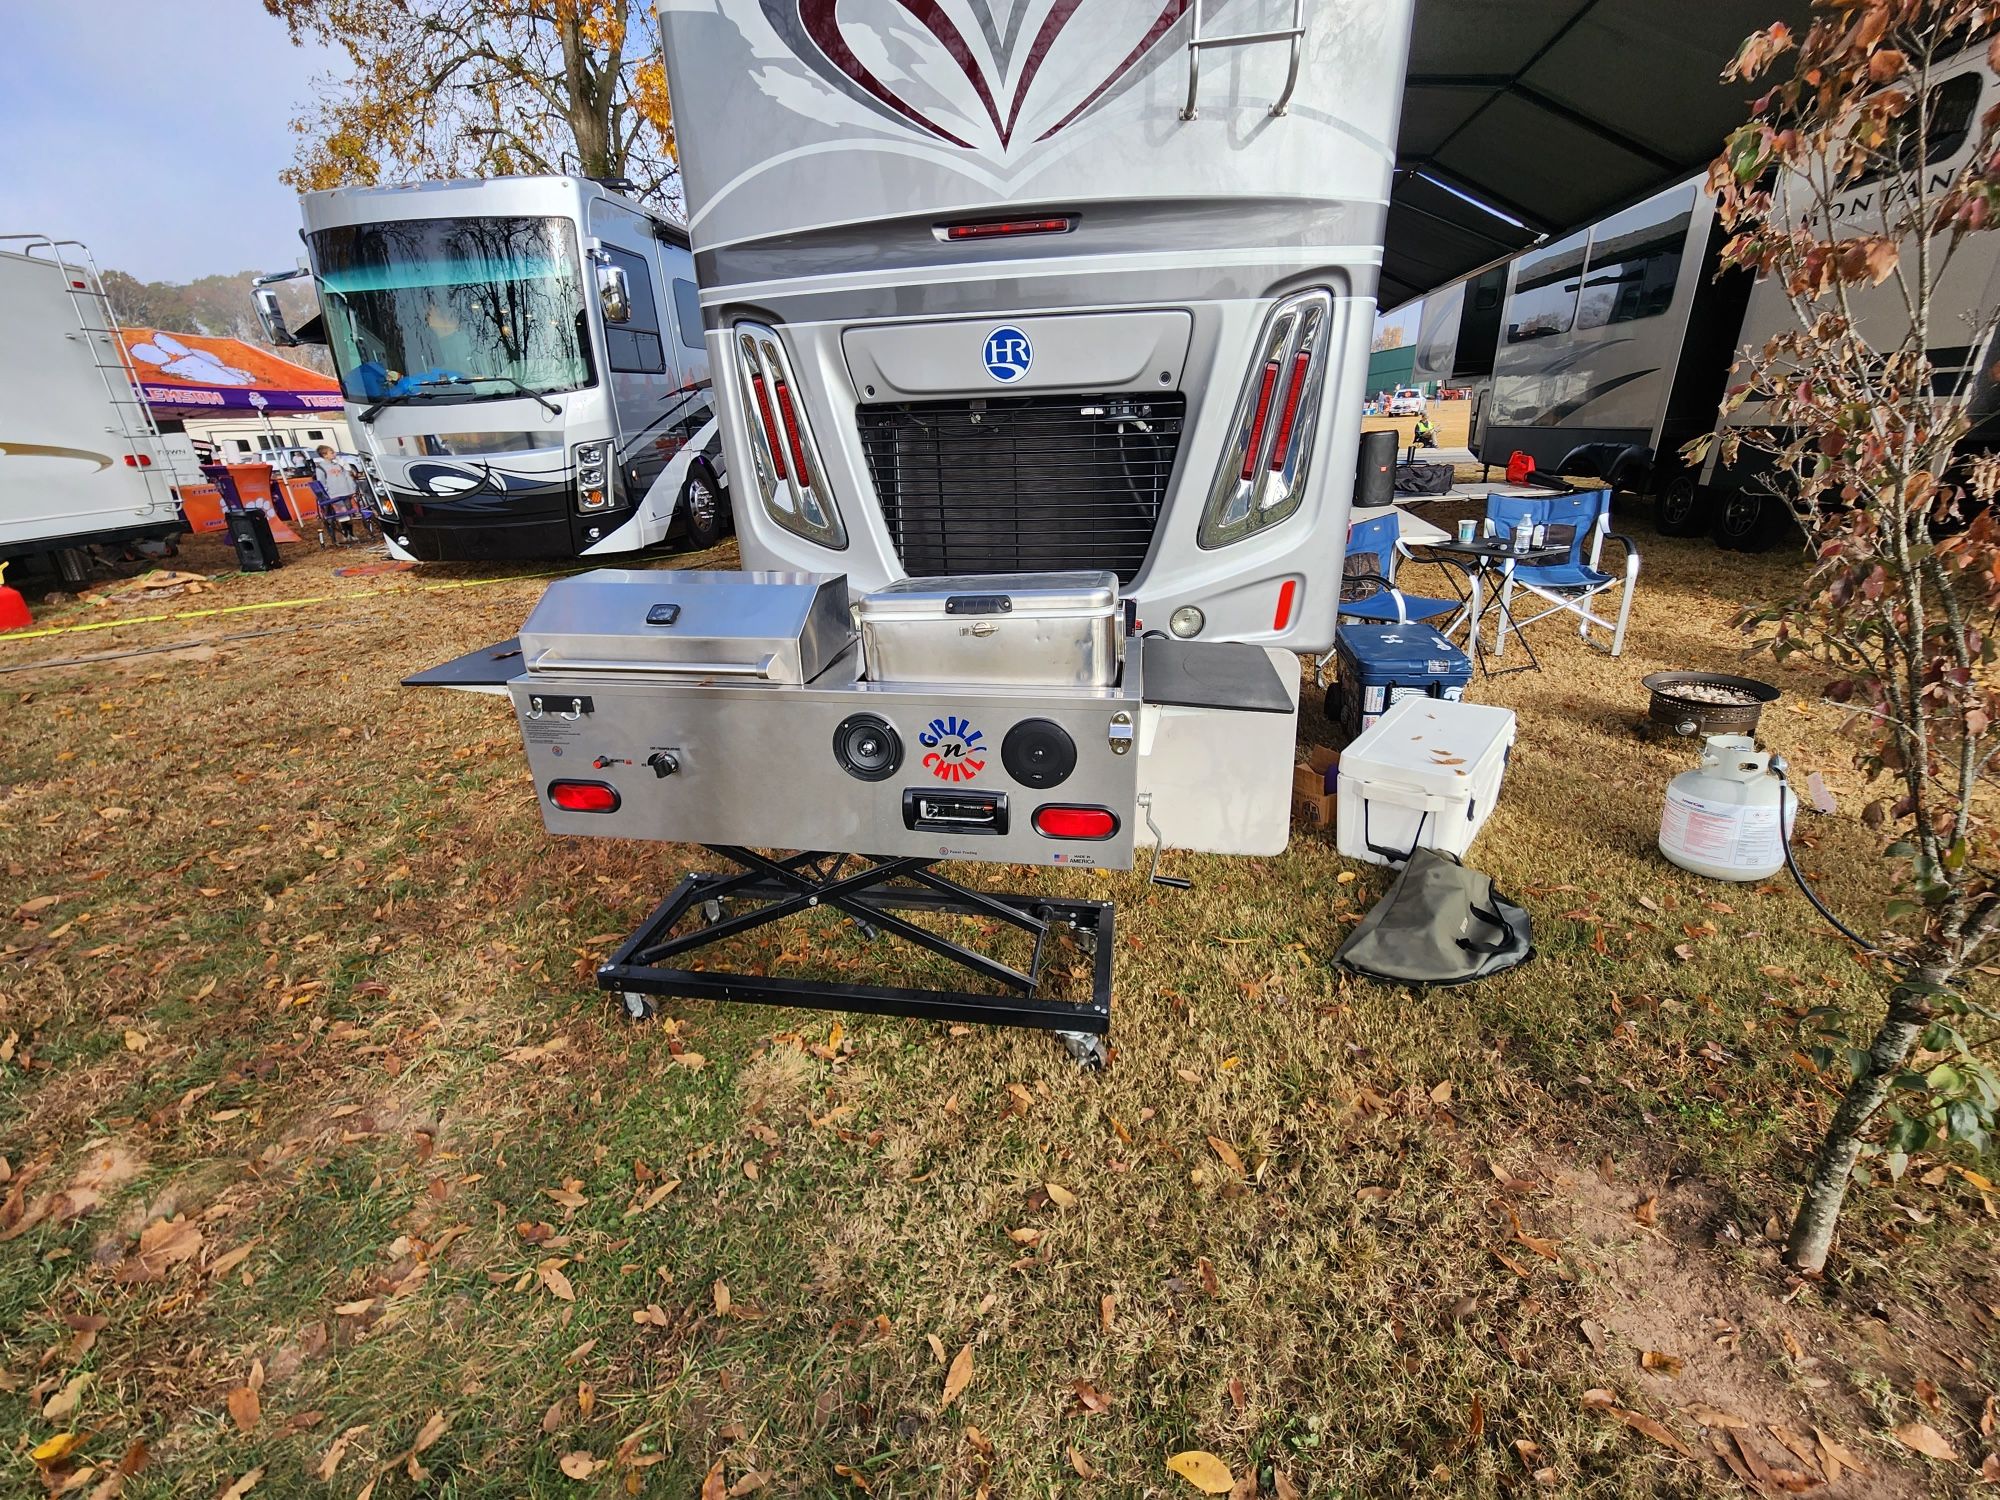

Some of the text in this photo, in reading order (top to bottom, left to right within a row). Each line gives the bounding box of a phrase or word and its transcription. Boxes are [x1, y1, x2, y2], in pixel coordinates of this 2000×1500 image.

[989, 338, 1030, 363] HR
[918, 716, 984, 749] GRILL
[922, 752, 986, 782] CHILL
